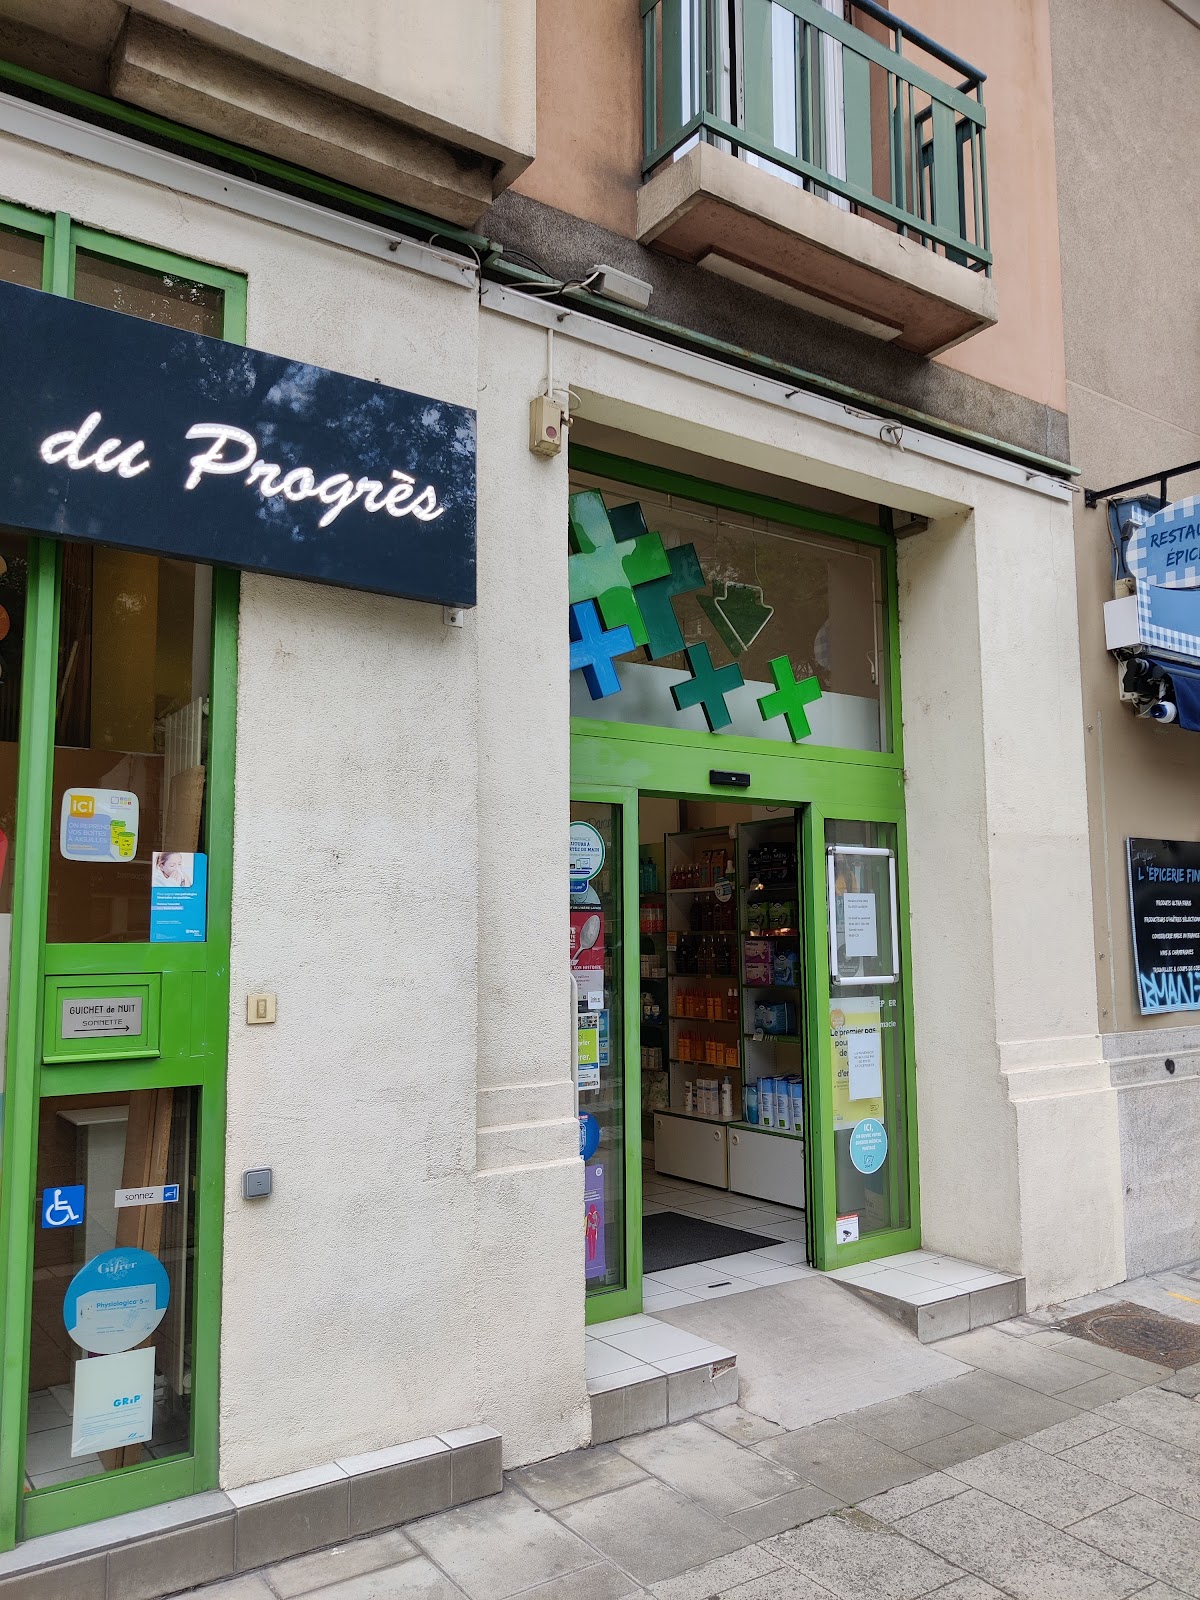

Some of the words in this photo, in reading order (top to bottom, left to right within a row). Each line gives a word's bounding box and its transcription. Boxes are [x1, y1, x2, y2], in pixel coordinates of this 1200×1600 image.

[41, 411, 149, 478] du
[185, 423, 444, 528] Progrès
[1166, 547, 1200, 567] ÉPIC
[69, 1005, 104, 1015] GUICHET
[118, 1004, 136, 1013] NUIT
[82, 1018, 123, 1026] SONNETTE
[830, 1028, 838, 1037] Le
[839, 1048, 848, 1057] de
[864, 1124, 874, 1132] ICI,
[125, 1192, 154, 1201] sonnez
[98, 1260, 137, 1274] Gifrer
